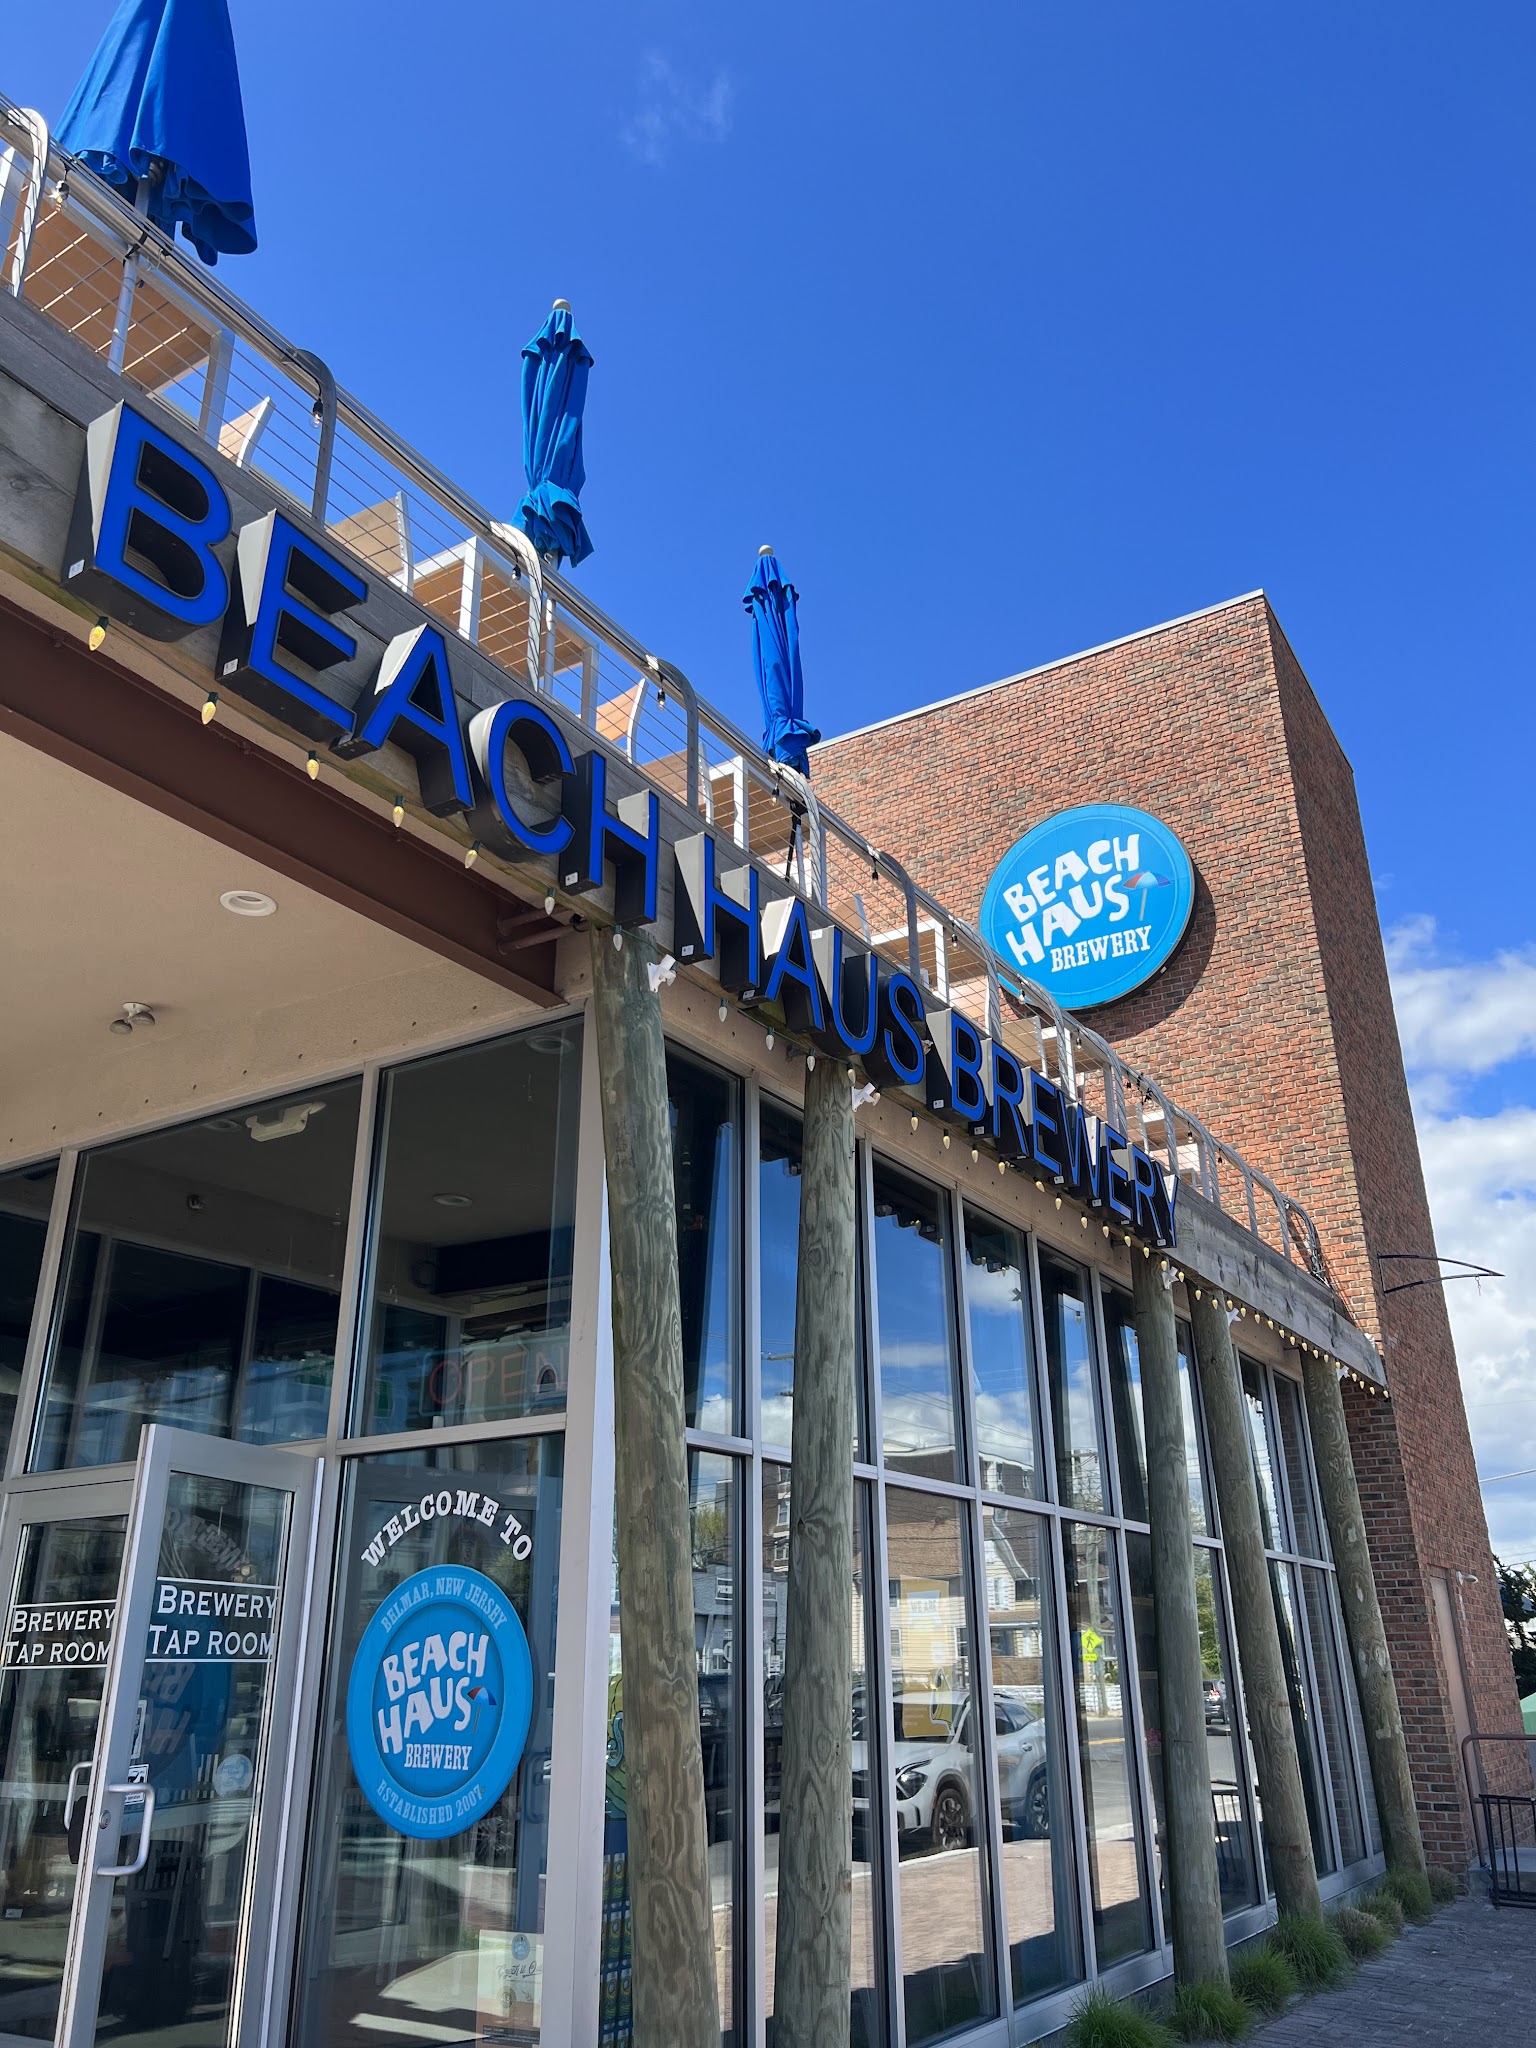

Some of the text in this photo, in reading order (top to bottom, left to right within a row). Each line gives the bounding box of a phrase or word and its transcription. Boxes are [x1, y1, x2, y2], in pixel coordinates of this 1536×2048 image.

[93, 400, 1180, 1248] BEACH HAUS BREWERY
[1002, 833, 1140, 923] BEACH
[1005, 874, 1129, 966] HAUS
[1049, 925, 1152, 973] BREWERY
[428, 1347, 565, 1405] OPEN
[360, 1489, 533, 1567] WELCOME TO
[12, 1607, 116, 1633] BREWERY
[157, 1584, 279, 1619] BREWERY
[435, 1576, 466, 1597] NEW
[464, 1583, 508, 1630] JERSEY
[5, 1640, 44, 1664] TAP
[149, 1624, 200, 1656] TAP
[382, 1630, 490, 1701] BEACH
[377, 1676, 472, 1755] HAUS
[403, 1743, 473, 1771] BREWERY
[376, 1779, 484, 1825] ESTABLISHED 2007
